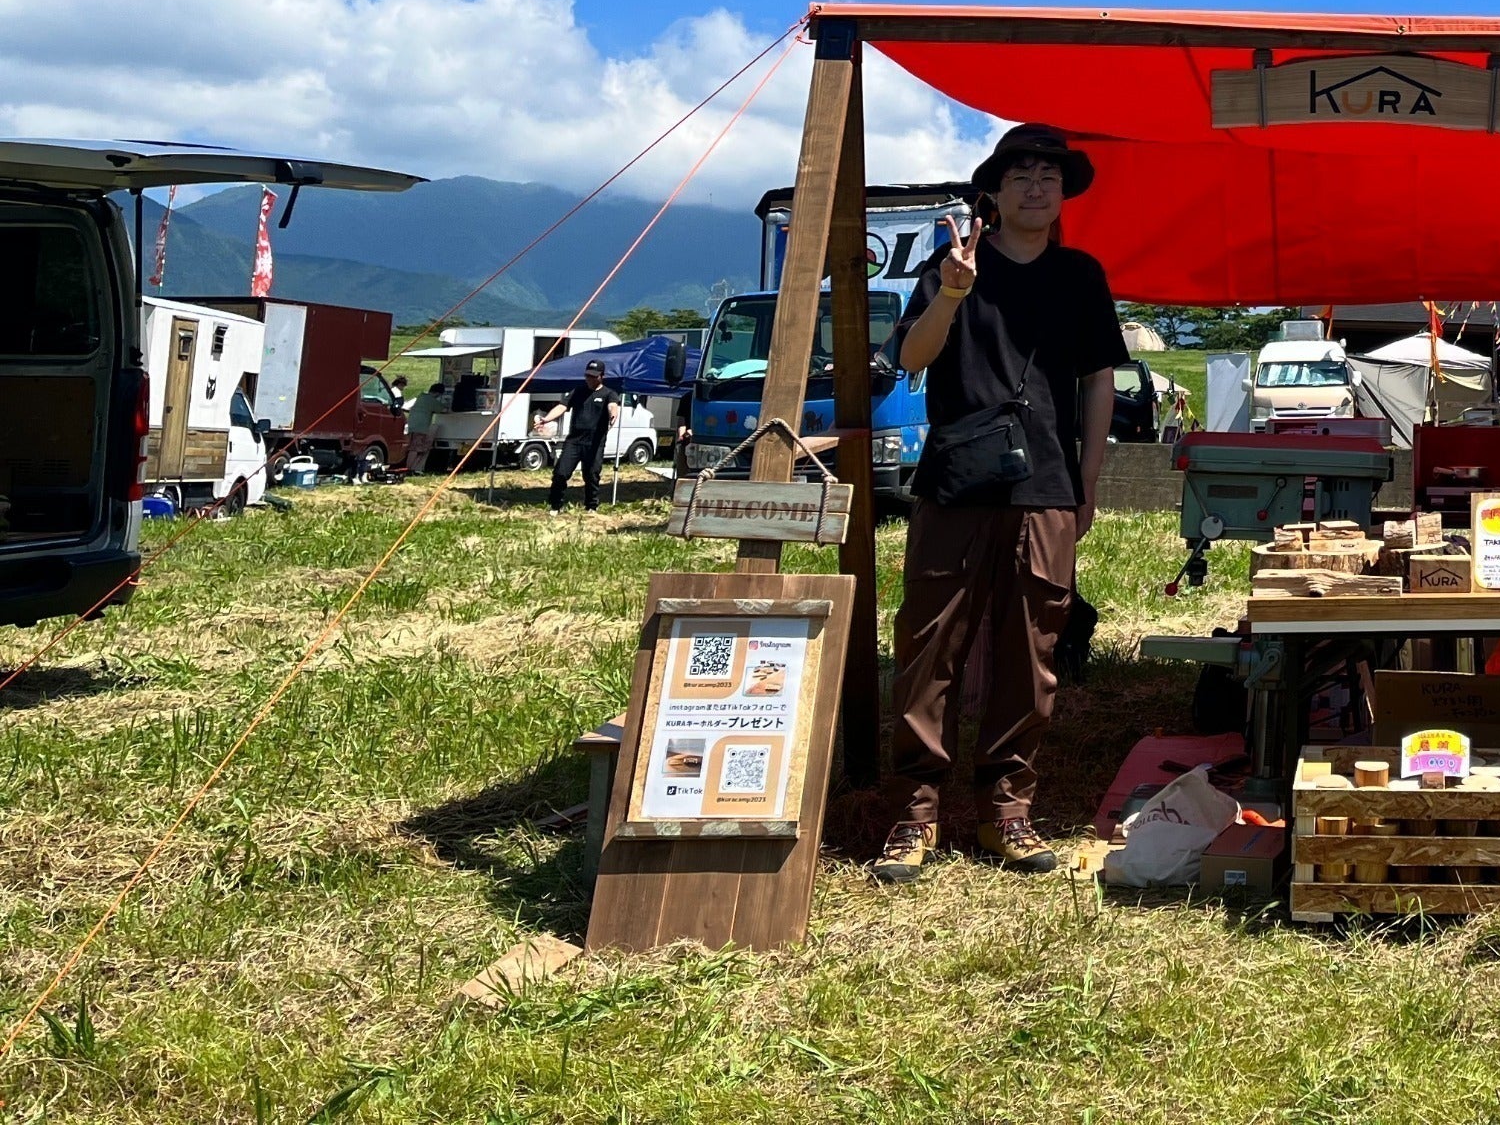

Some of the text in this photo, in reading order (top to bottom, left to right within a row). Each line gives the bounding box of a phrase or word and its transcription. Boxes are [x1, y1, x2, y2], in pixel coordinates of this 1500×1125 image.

[1309, 65, 1442, 116] KURA
[694, 498, 817, 523] WELCOME
[1419, 567, 1463, 588] KURA
[759, 640, 792, 651] Instagram
[677, 787, 703, 795] TikTok
